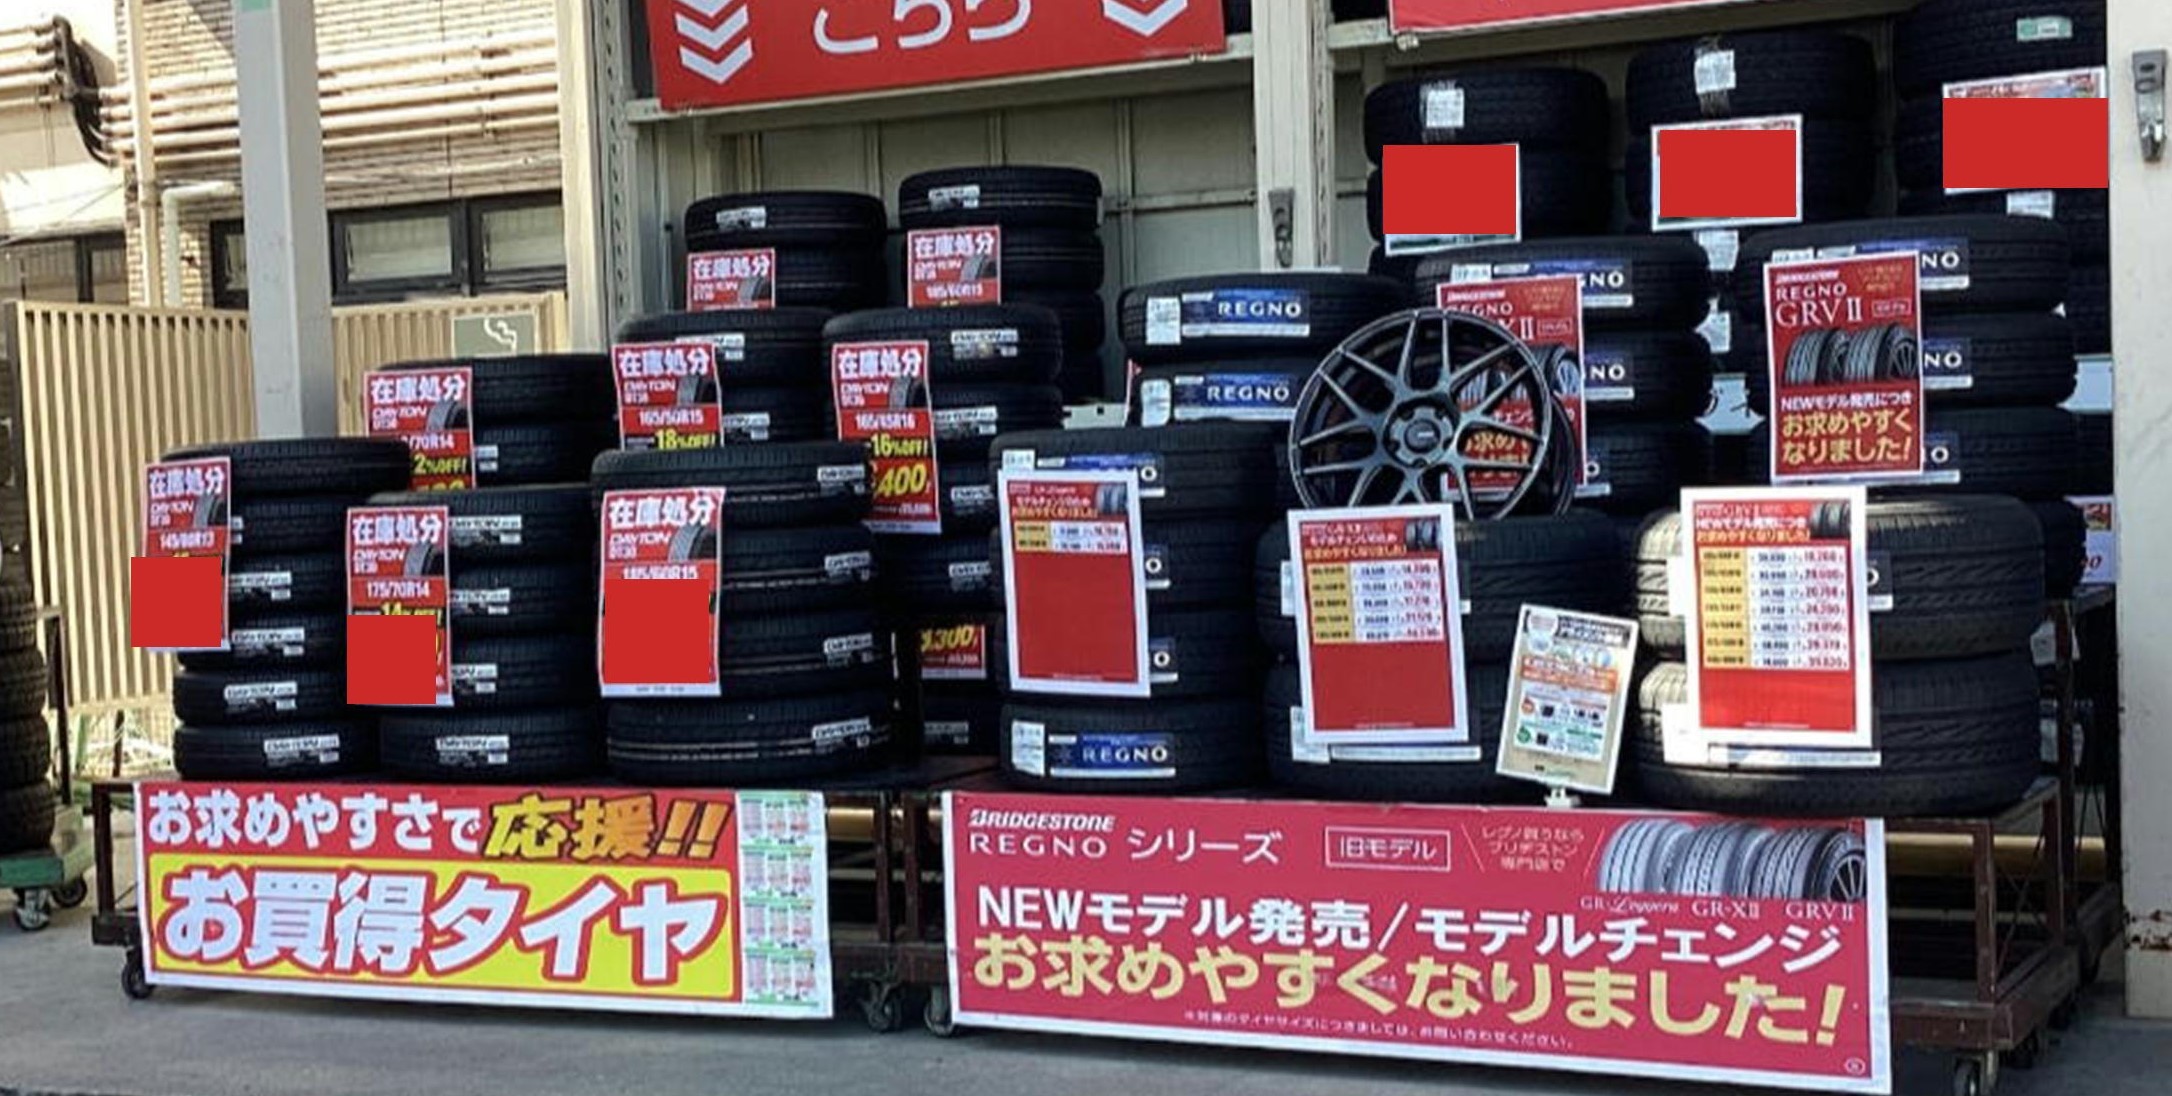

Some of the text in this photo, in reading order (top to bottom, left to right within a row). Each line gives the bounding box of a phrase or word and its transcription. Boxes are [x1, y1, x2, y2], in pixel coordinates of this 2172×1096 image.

[914, 233, 995, 259] 在庫処分
[693, 255, 770, 280] 在庫処分
[1776, 282, 1848, 301] REGNO
[1218, 301, 1301, 317] REGNO
[618, 347, 711, 377] 在庫処分
[839, 348, 922, 378] 在庫処分
[371, 374, 466, 404] 在庫処分
[1207, 386, 1290, 401] REGNO
[1782, 406, 1914, 437] お求めやすく
[1781, 436, 1912, 466] なりました!
[149, 466, 226, 499] 在庫処分
[608, 496, 716, 530] 在庫処分
[353, 513, 443, 546] 在庫処分
[1082, 747, 1168, 763] REGNO
[969, 809, 1116, 832] BRIDGESTONE
[970, 828, 1284, 865] REGNO シリーズ
[1338, 835, 1438, 861] 旧モデル
[165, 868, 718, 981] お買得タイヤ
[973, 932, 1846, 1048] お求めやすくなりました!
